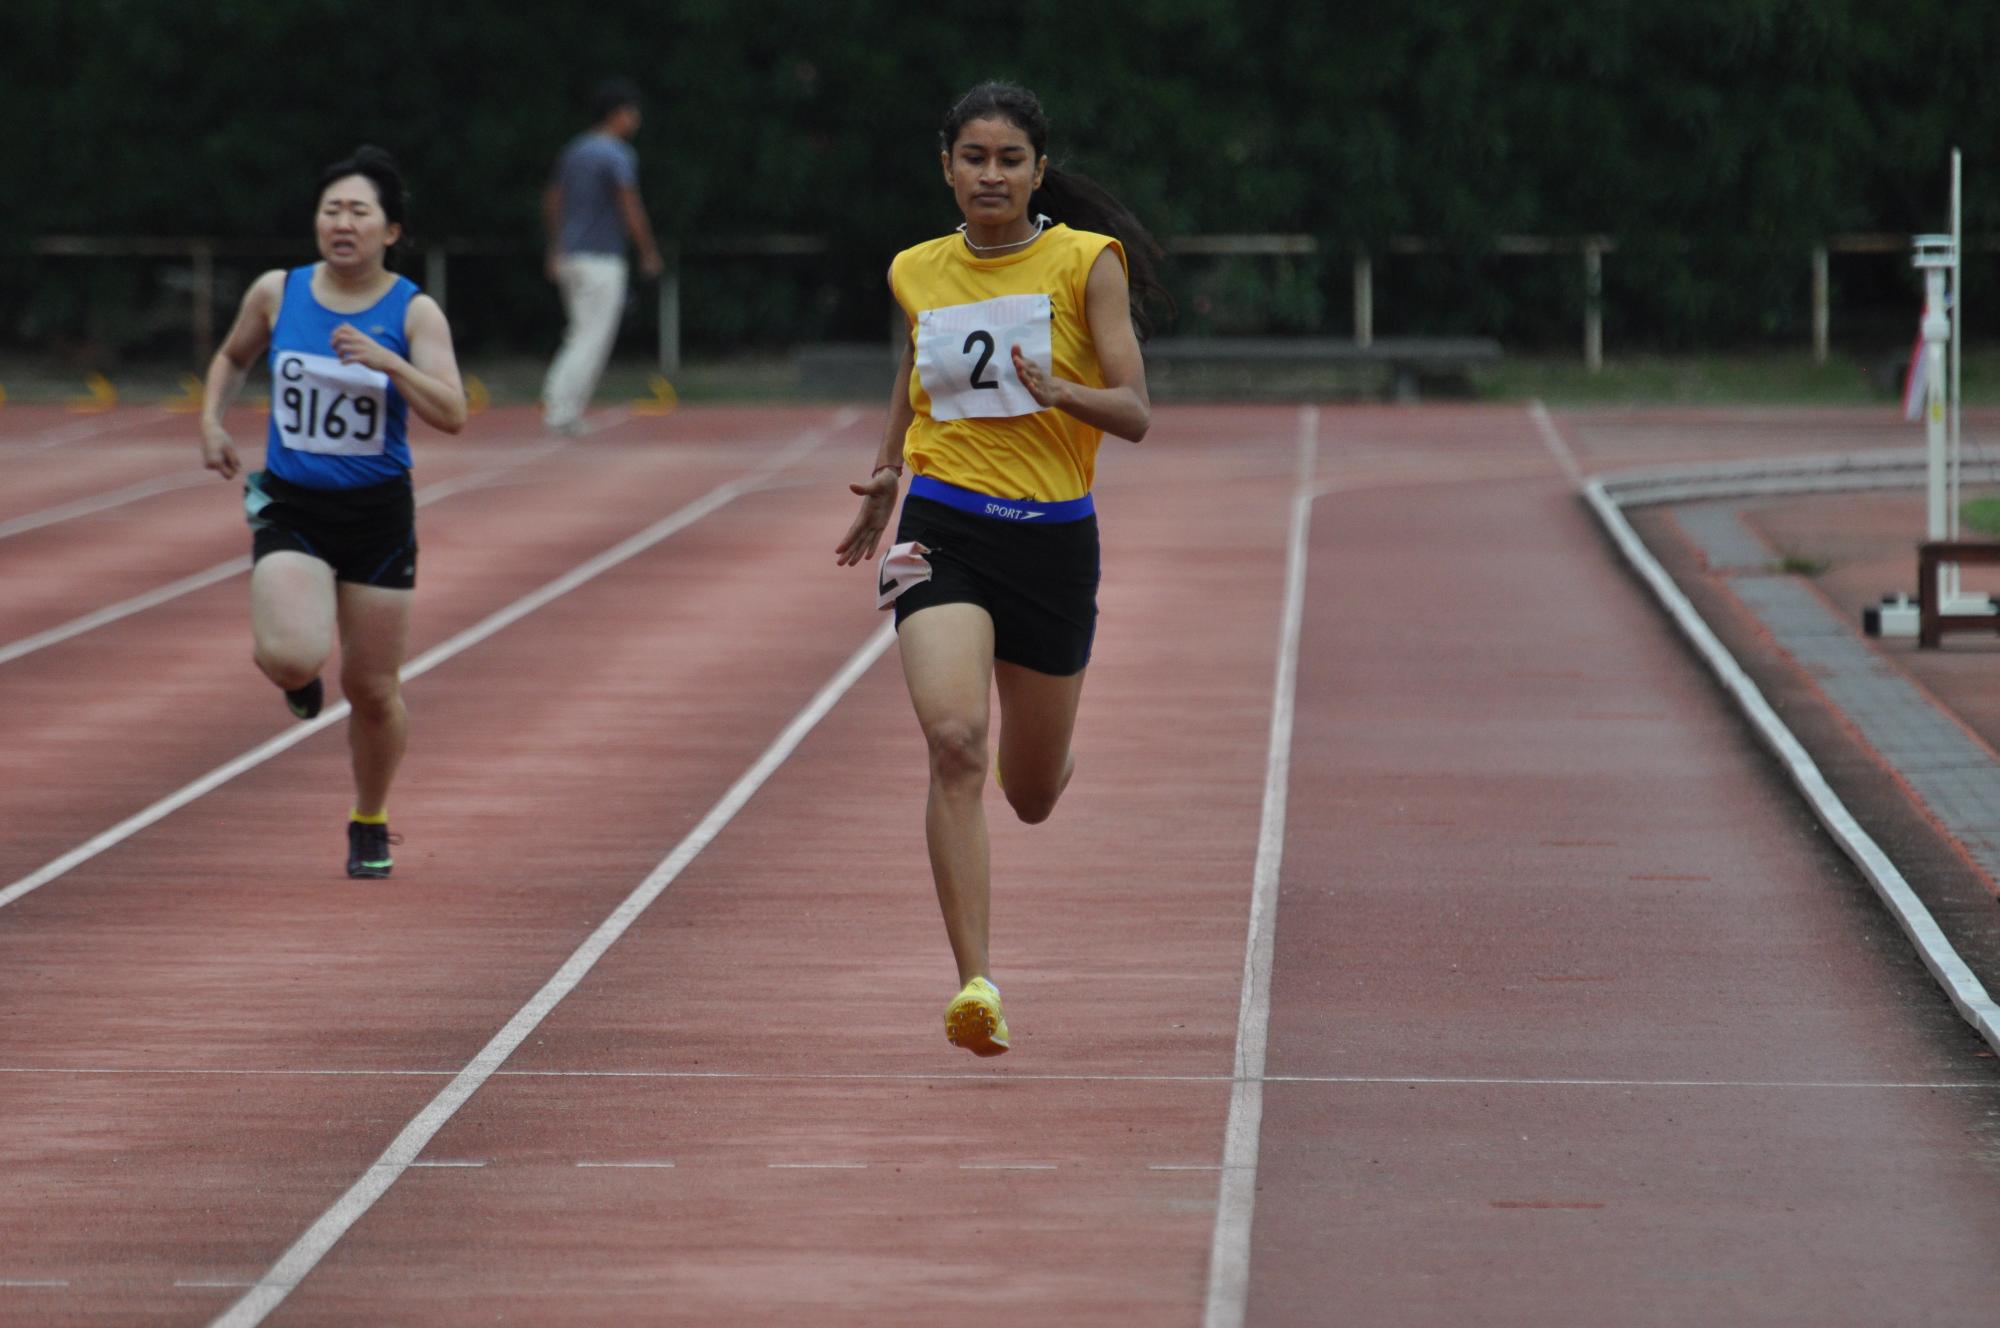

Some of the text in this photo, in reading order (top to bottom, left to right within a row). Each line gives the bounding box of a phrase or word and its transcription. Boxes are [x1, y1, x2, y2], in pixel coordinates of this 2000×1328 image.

[282, 358, 304, 382] C
[962, 330, 999, 389] 2
[283, 387, 378, 441] 9169
[985, 503, 1023, 519] SPORT
